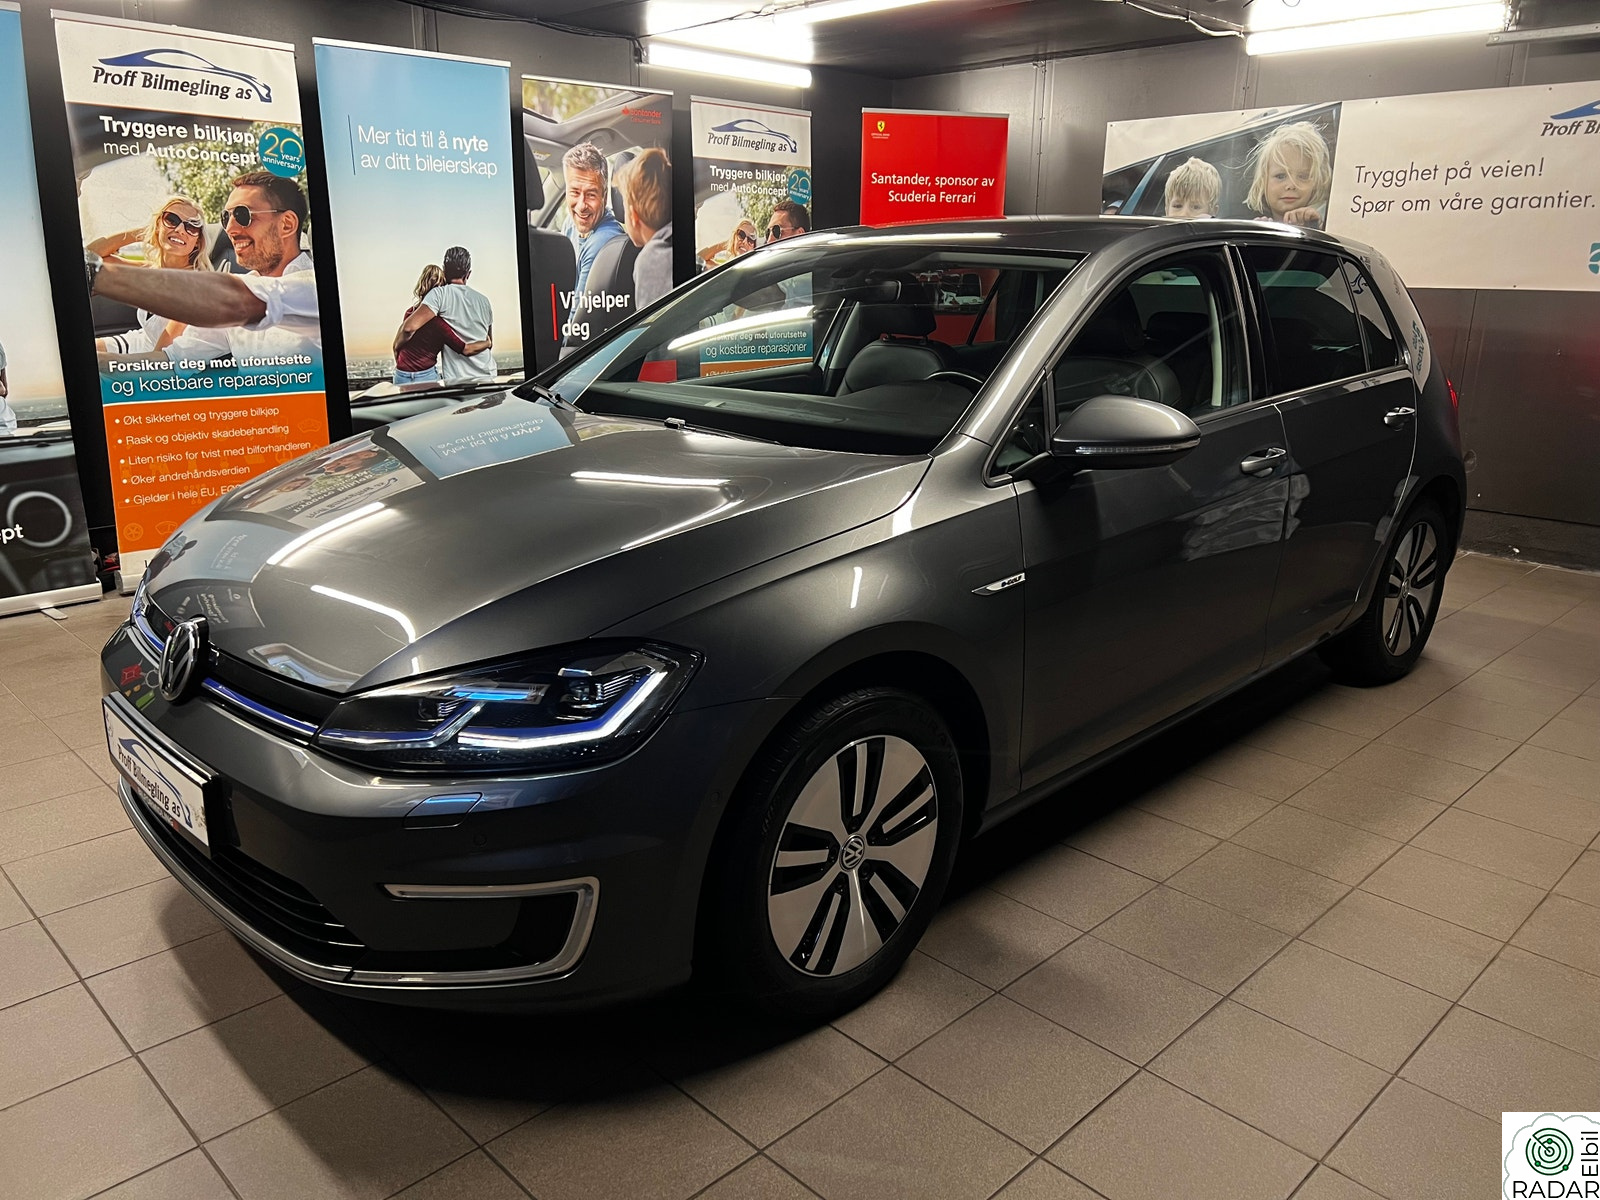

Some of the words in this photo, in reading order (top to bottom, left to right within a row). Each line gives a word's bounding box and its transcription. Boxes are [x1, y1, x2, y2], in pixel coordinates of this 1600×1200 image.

[92, 66, 138, 86] Proff
[140, 72, 231, 100] Bilmegling
[236, 87, 252, 100] as
[98, 115, 188, 139] Tryggere
[194, 124, 254, 145] bilkjøp
[1540, 120, 1584, 136] Proff
[1584, 120, 1600, 134] Bi
[264, 133, 302, 158] 20
[358, 125, 392, 145] Mer
[395, 128, 417, 146] tid
[420, 130, 434, 148] til
[438, 130, 448, 149] å
[452, 136, 488, 154] nyte
[708, 132, 730, 145] Proff
[732, 135, 776, 152] Bilmegling
[778, 144, 788, 152] as
[104, 142, 140, 156] med
[146, 143, 257, 166] AutoConcept
[262, 156, 302, 171] anniversary
[281, 154, 300, 162] years
[360, 154, 380, 168] av
[385, 152, 412, 170] ditt
[416, 154, 498, 179] bileierskap
[710, 165, 752, 180] Tryggere
[756, 170, 786, 183] bilkjøp
[1354, 161, 1438, 188] Trygghet
[1444, 161, 1472, 186] på
[1480, 157, 1545, 178] veien!
[710, 182, 728, 192] med
[731, 183, 788, 196] AutoConcept
[871, 172, 932, 187] Santander,
[934, 176, 978, 188] sponsor
[981, 178, 994, 186] av
[888, 190, 936, 202] Scuderia
[940, 192, 976, 204] Ferrari
[1350, 195, 1394, 218] Spør
[1401, 196, 1430, 212] om
[1440, 192, 1483, 210] våre
[1490, 191, 1596, 216] garantier.
[560, 290, 575, 309] Vi
[580, 290, 630, 314] hjelper
[562, 319, 590, 340] deg
[706, 348, 716, 358] og
[720, 344, 756, 356] kostbare
[758, 342, 807, 355] reparasjoner
[108, 360, 175, 372] Forsikrer
[180, 358, 206, 370] deg
[210, 357, 237, 368] mot
[241, 354, 312, 367] uforutsette
[112, 381, 134, 396] og
[140, 374, 213, 392] kostbare
[218, 371, 312, 390] reparasjoner
[123, 415, 142, 426] Økt
[146, 412, 190, 423] sikkerhet
[193, 412, 206, 422] og
[209, 410, 248, 421] tryggere
[250, 407, 280, 416] bilkjøp
[126, 433, 152, 446] Rask
[155, 435, 168, 444] og
[172, 430, 209, 444] objektiv
[212, 425, 289, 438] skadebehandling
[128, 456, 154, 466] Liten
[156, 452, 182, 462] risiko
[186, 450, 198, 460] for
[201, 449, 220, 458] tvist
[224, 446, 244, 456] med
[247, 441, 310, 454] bilforhandleren
[130, 474, 156, 485] Øker
[159, 466, 250, 483] andrehåndsverdien
[134, 492, 170, 506] Gjelder
[178, 490, 198, 500] hele
[0, 524, 24, 544] pt
[132, 759, 170, 810] Bilmegling
[172, 802, 180, 818] as
